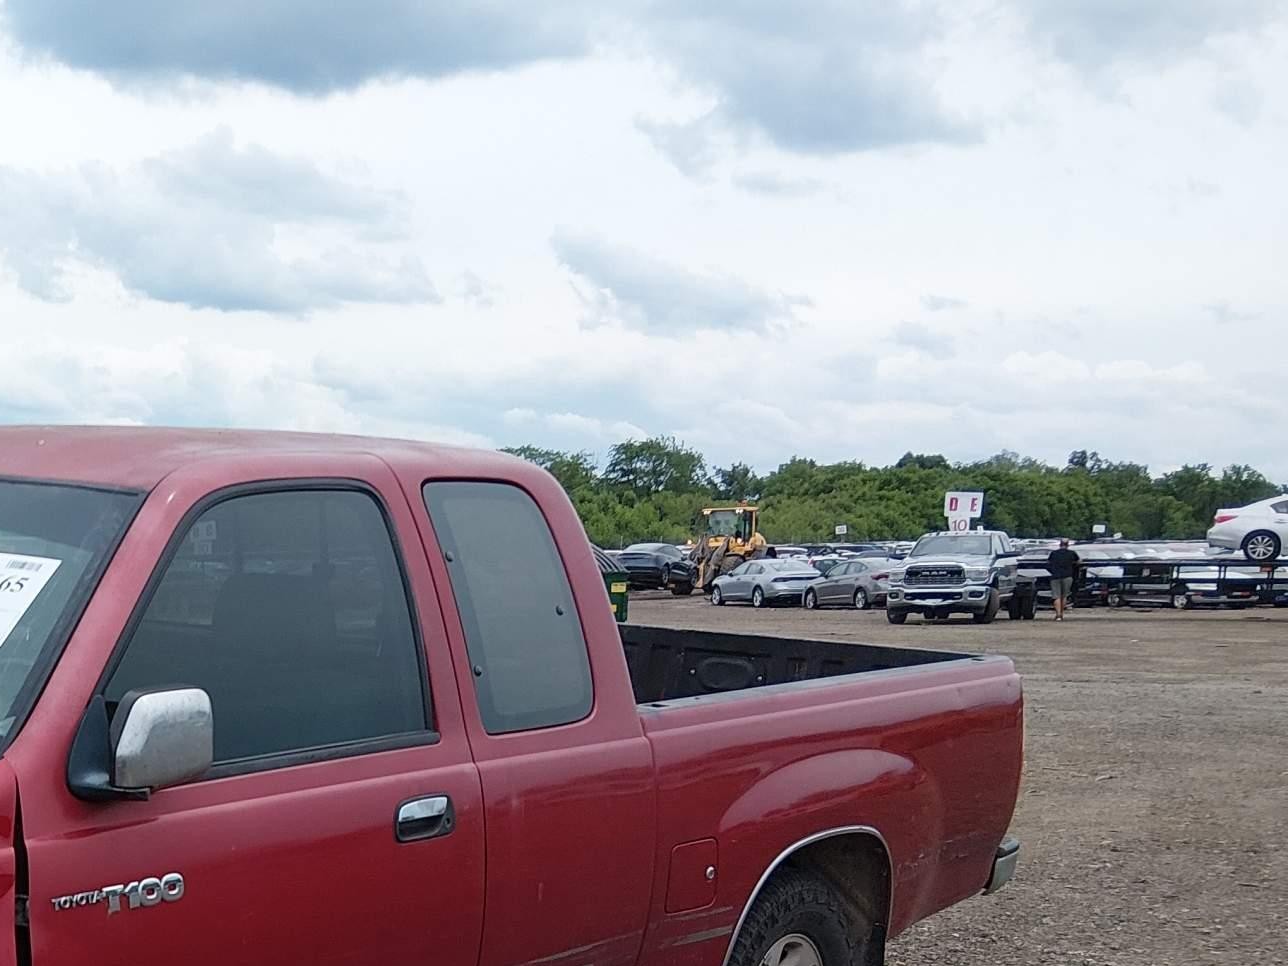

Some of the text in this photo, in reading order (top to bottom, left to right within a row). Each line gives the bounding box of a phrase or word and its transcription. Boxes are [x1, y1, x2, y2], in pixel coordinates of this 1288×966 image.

[948, 496, 979, 512] D E
[952, 519, 968, 532] 10
[51, 872, 185, 917] TOYOTA T100
